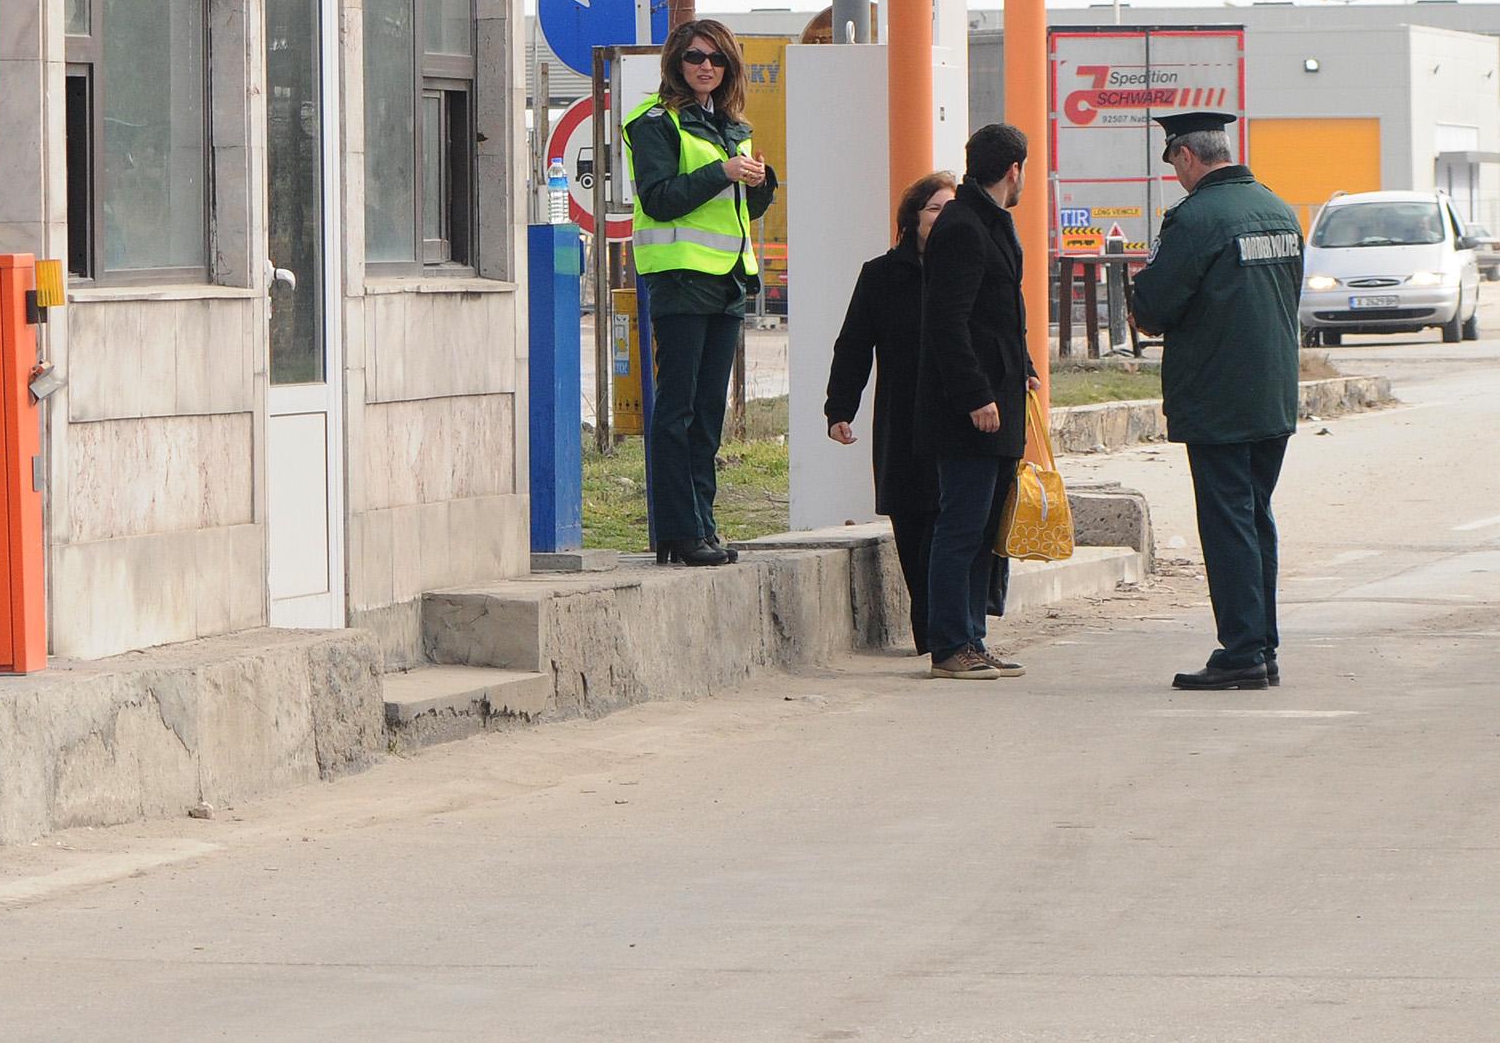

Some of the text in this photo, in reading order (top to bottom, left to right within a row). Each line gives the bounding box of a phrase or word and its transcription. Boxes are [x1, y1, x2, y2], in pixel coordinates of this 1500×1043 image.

[1097, 90, 1176, 106] SCHWARZ
[1061, 209, 1090, 227] TIR
[1093, 208, 1111, 216] LONG
[1239, 233, 1301, 261] BORDER POLICE
